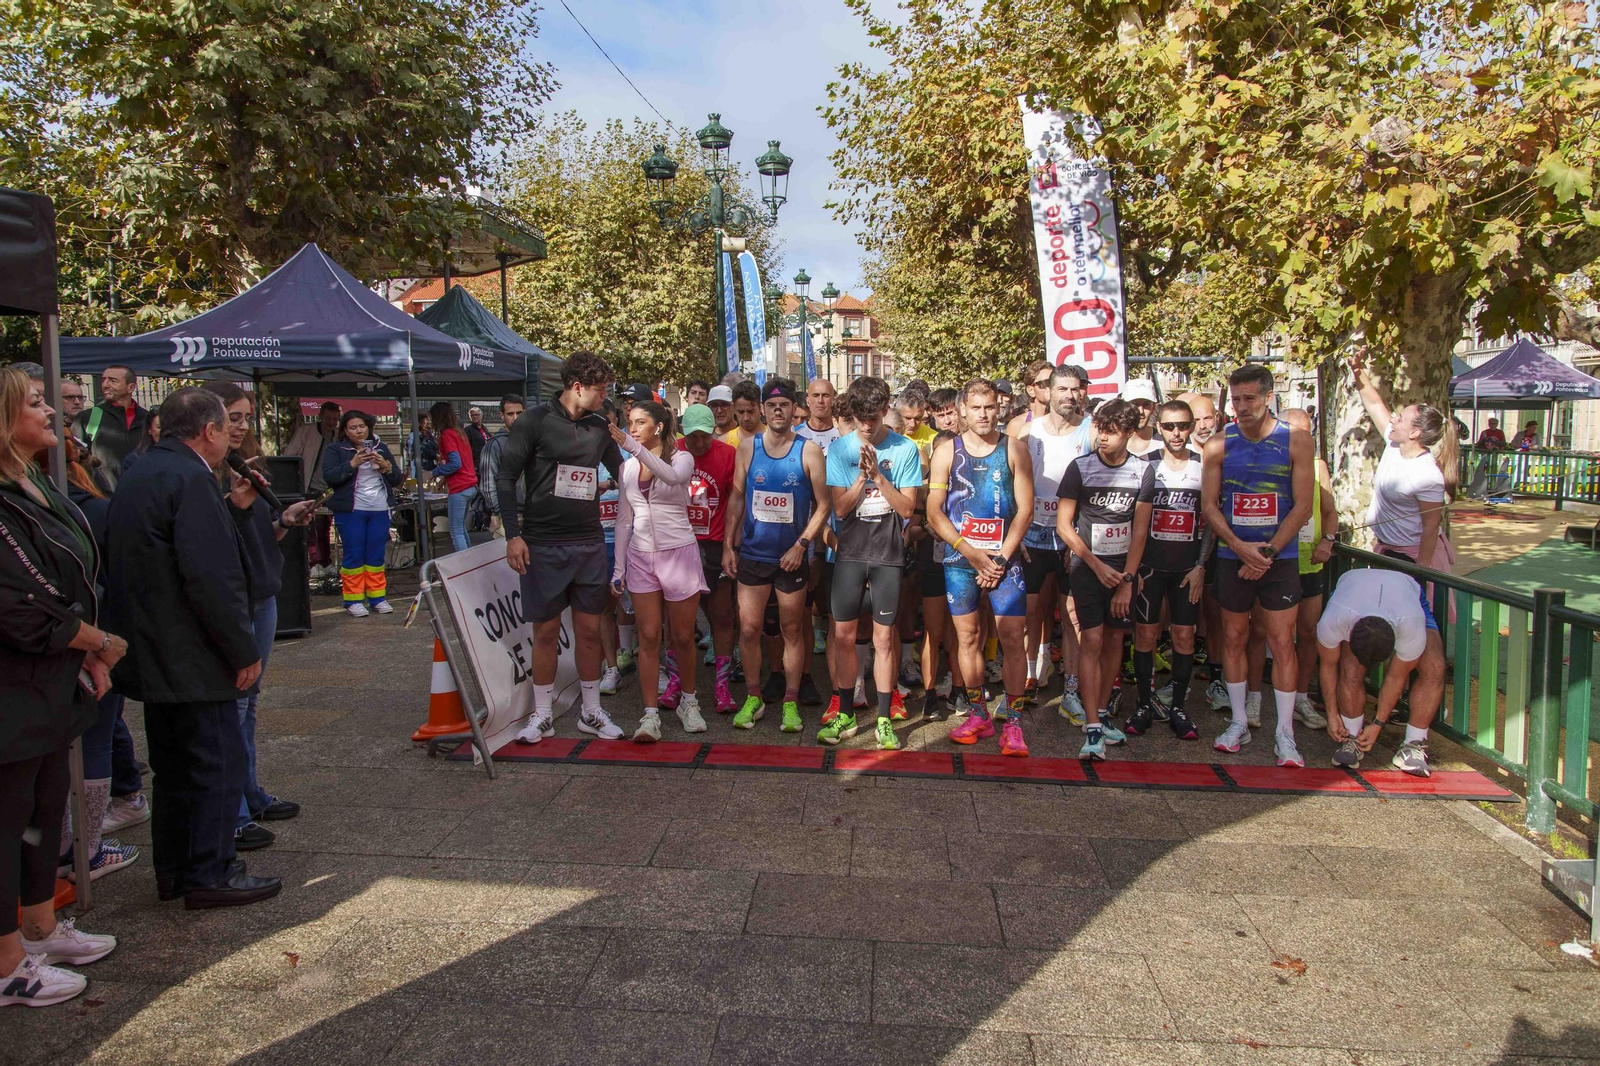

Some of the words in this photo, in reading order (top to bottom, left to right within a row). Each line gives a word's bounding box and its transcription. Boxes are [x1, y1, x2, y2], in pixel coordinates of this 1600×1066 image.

[1080, 170, 1098, 178] VIGO
[1068, 202, 1084, 250] mellor
[1045, 204, 1070, 288] deporte
[1074, 251, 1086, 275] teu
[212, 336, 281, 348] Deputación
[213, 348, 281, 358] Pontevedra
[472, 346, 494, 358] Deputación
[472, 356, 495, 368] Pontevedra
[571, 471, 593, 483] 675
[865, 487, 884, 499] 52
[764, 496, 787, 507] 608
[1243, 498, 1269, 509] 223
[689, 509, 704, 520] 33
[1169, 514, 1185, 526] 73
[971, 522, 996, 534] 209
[1105, 526, 1128, 538] 814
[6, 534, 18, 547] VIP
[14, 546, 39, 575] PRIVATE
[35, 572, 48, 584] VIP
